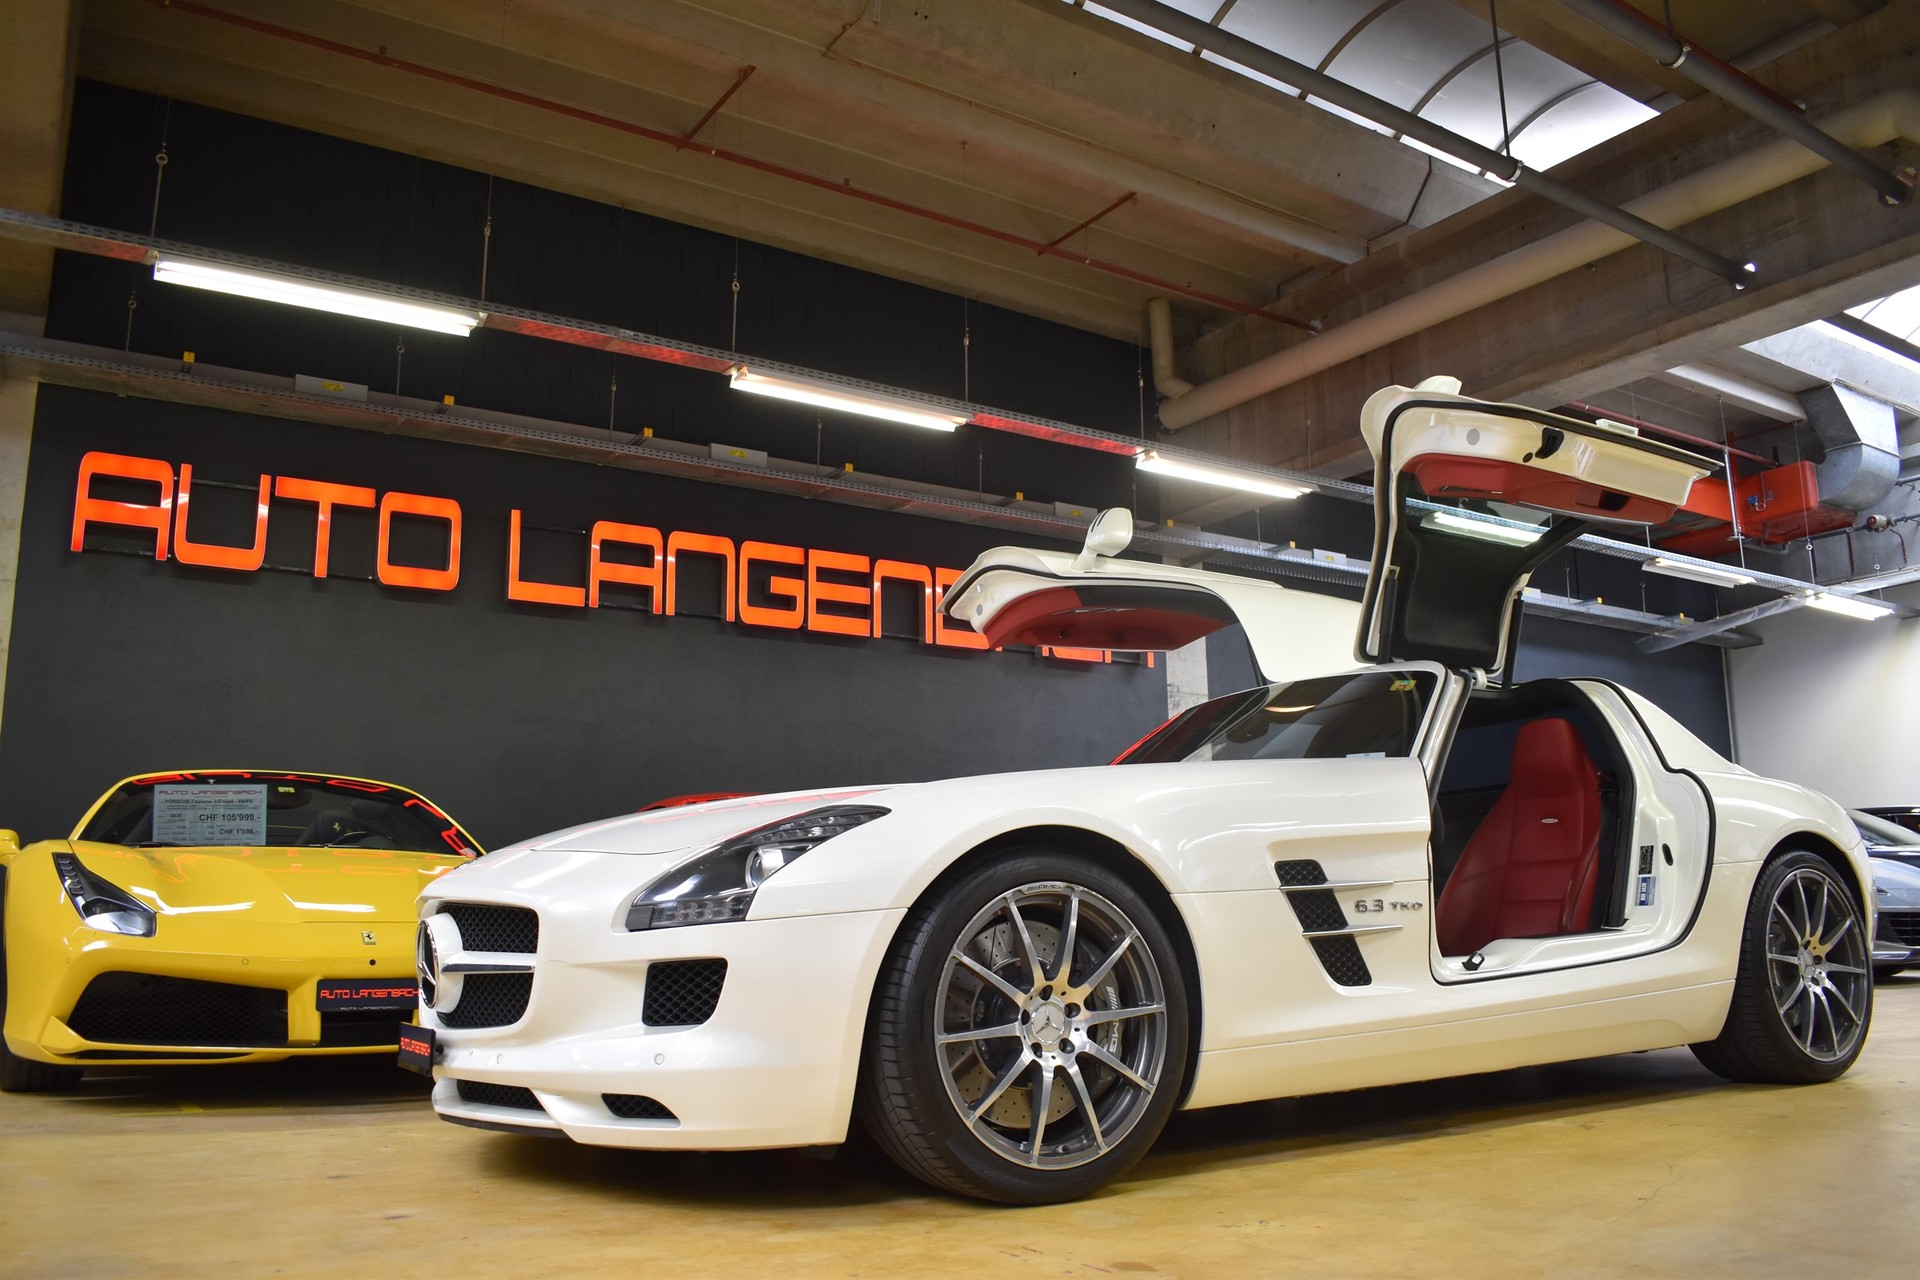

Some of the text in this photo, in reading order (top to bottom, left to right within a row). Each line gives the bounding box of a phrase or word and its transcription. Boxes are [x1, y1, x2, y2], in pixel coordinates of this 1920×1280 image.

[71, 451, 462, 591] AUTO
[199, 813, 260, 822] CHF 105'999.-
[1354, 899, 1384, 914] 6.3
[320, 988, 419, 999] AUTO LANGENBACH
